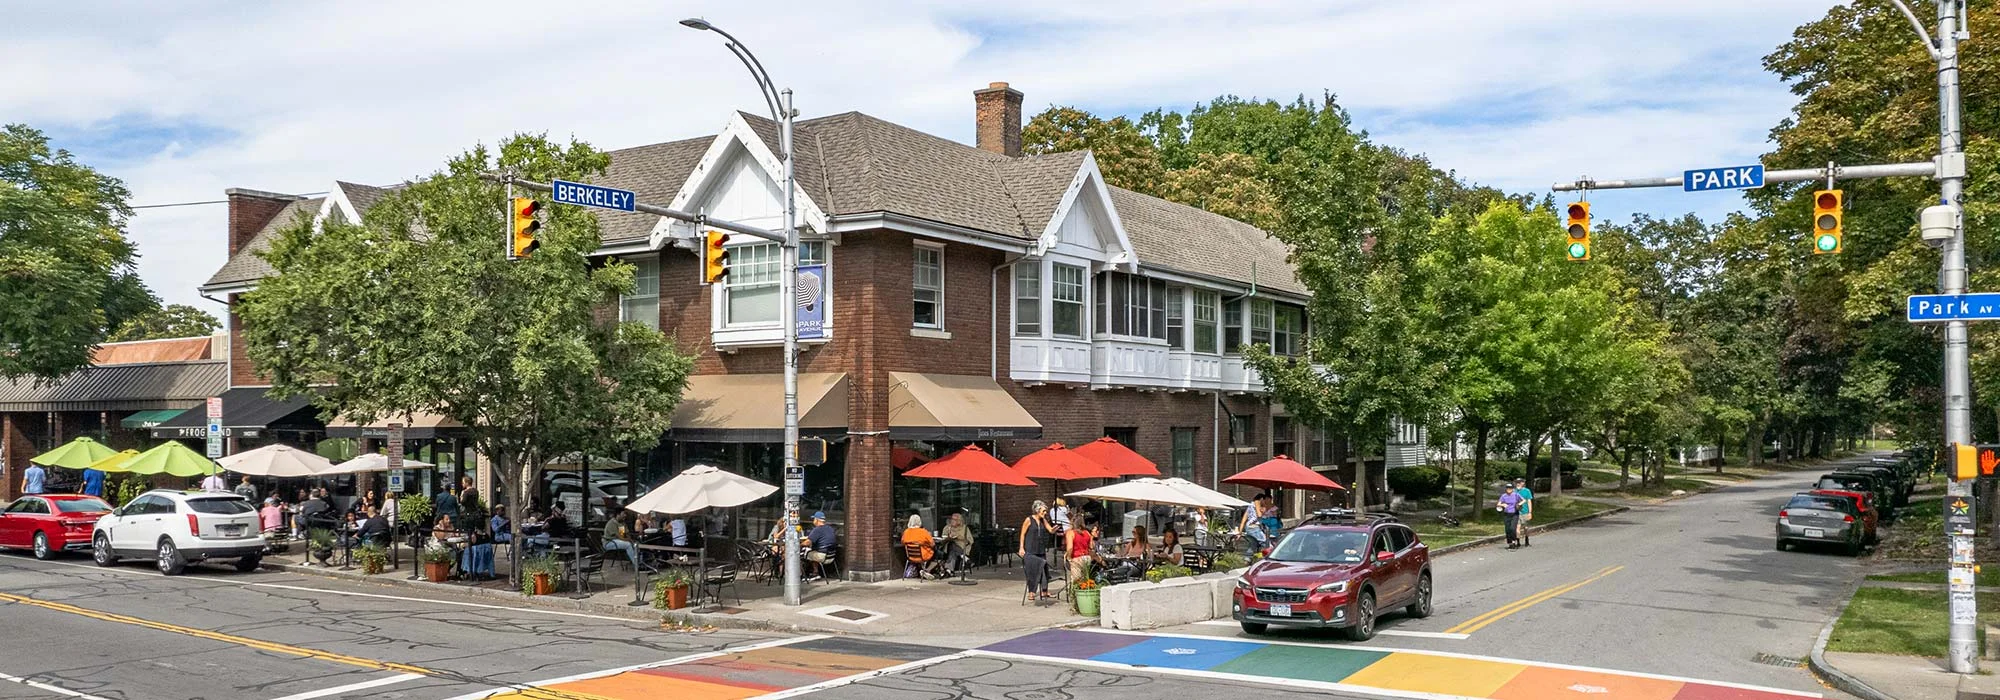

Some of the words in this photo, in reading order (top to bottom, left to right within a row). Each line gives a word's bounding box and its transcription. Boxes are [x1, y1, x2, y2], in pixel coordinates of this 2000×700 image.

[1692, 167, 1754, 190] PARK
[558, 184, 630, 209] BERKELEY
[1919, 300, 1969, 315] Park
[1979, 305, 1993, 314] AV
[186, 428, 205, 436] FROG
